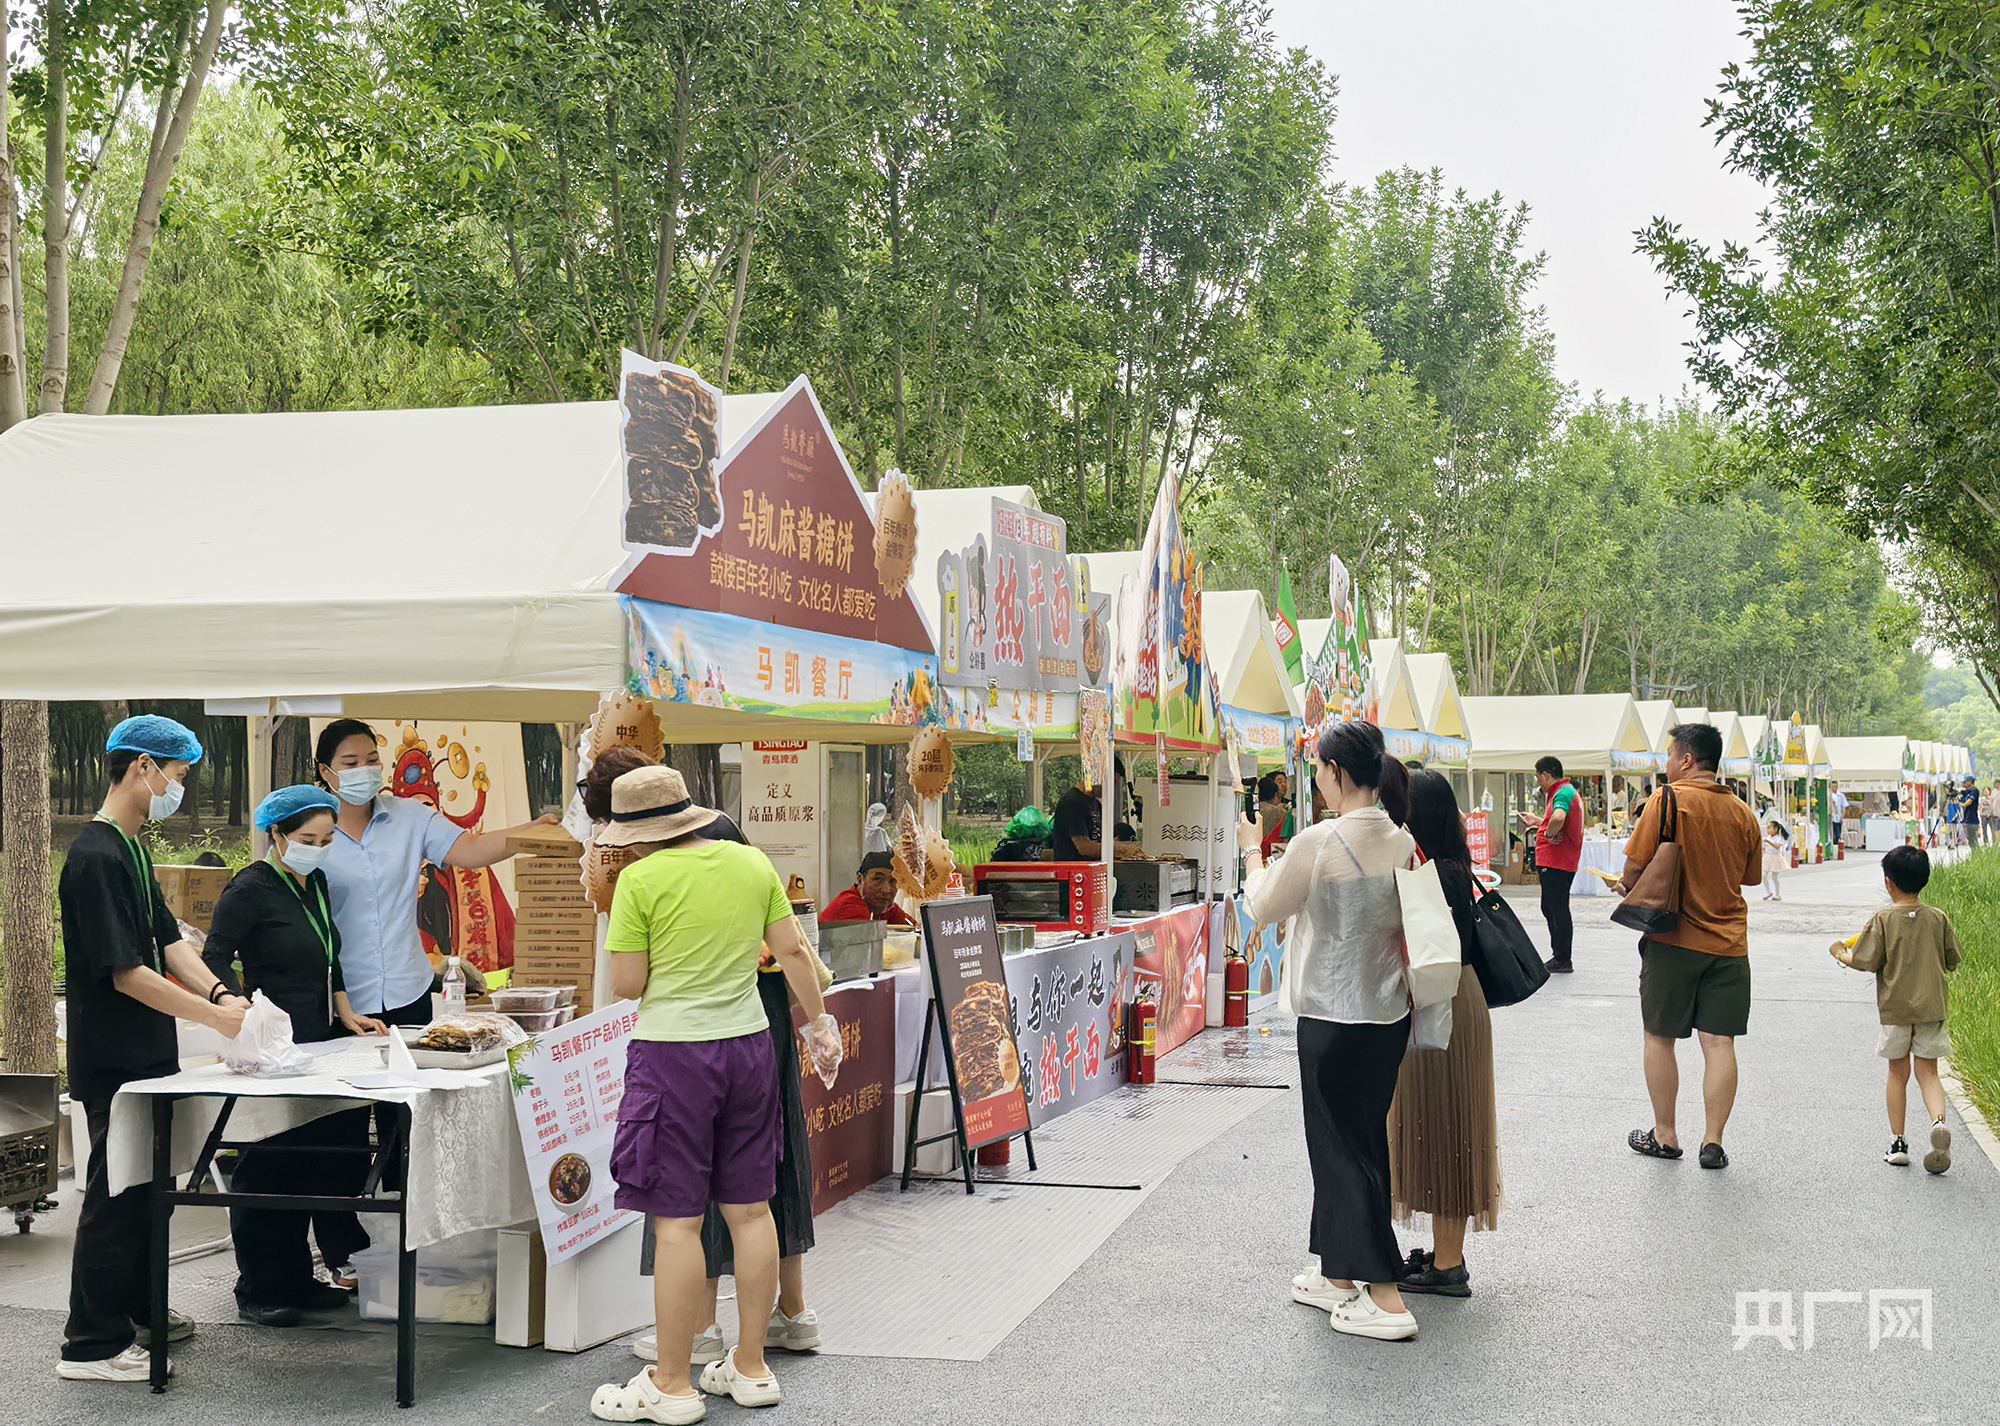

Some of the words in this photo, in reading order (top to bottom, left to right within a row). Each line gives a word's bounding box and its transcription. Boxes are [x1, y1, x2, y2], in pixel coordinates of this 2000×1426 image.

[739, 489, 855, 574] 马凯麻酱糖饼
[710, 551, 793, 602] 鼓楼百年名小吃
[797, 578, 877, 622] 文化名人都爱吃
[993, 552, 1073, 667] 热干面
[757, 646, 853, 701] 马凯餐厅
[615, 724, 639, 740] 中华
[762, 754, 799, 765] 青岛啤酒
[921, 749, 942, 763] 20层
[766, 782, 793, 799] 定义
[748, 805, 814, 823] 高品质原浆
